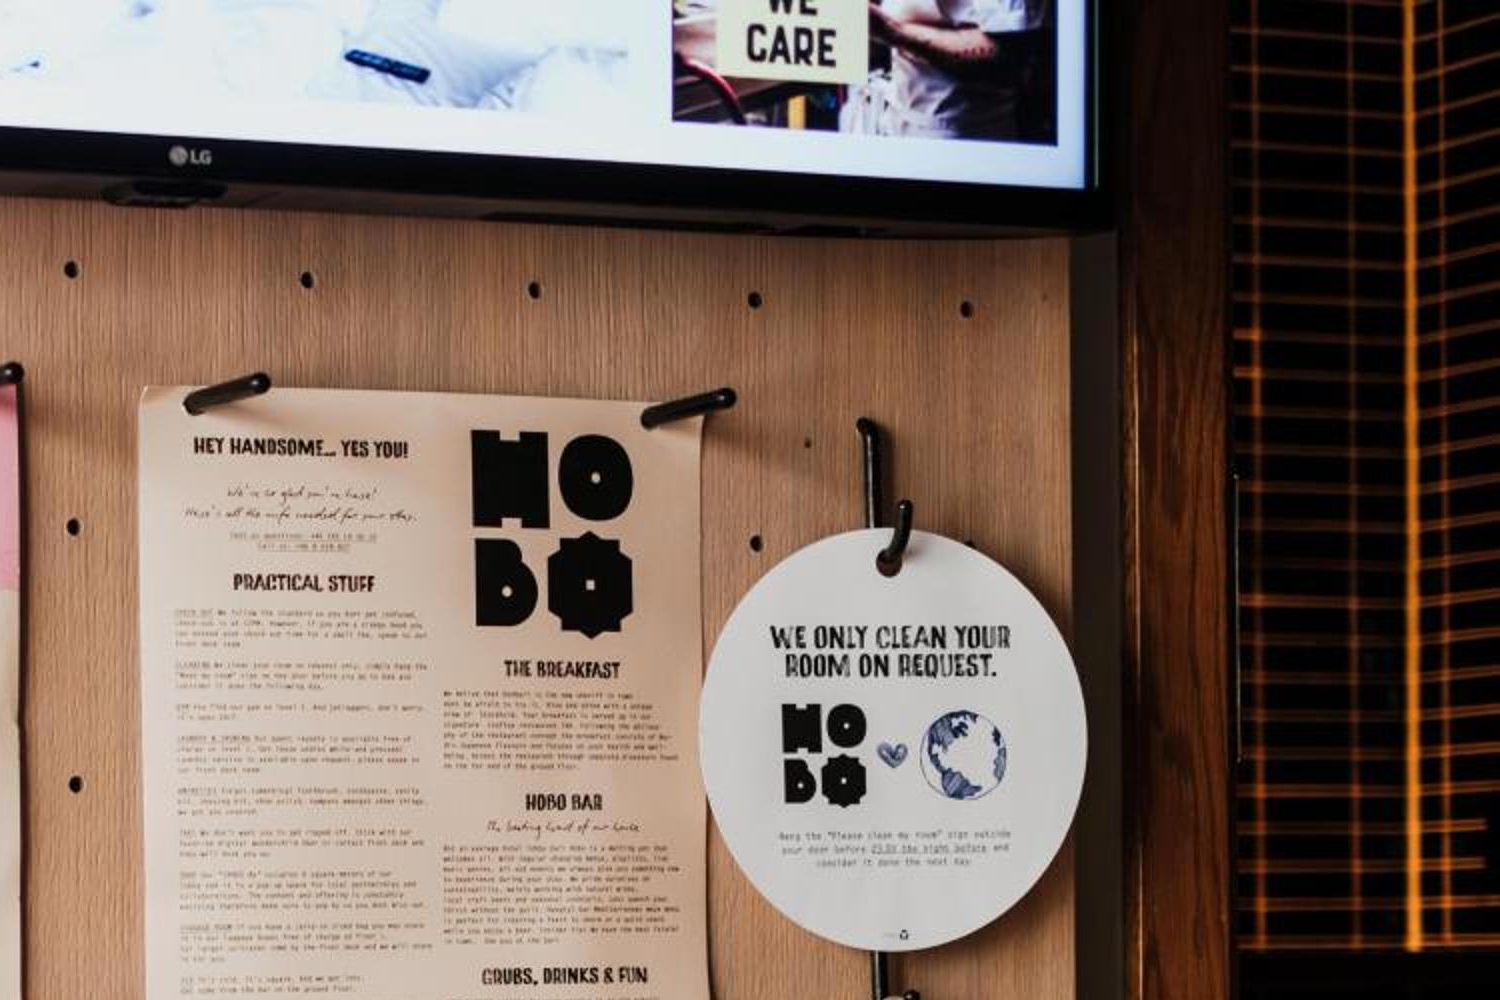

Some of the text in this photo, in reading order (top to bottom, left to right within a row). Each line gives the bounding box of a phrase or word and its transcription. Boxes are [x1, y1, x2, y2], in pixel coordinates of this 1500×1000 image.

[747, 24, 836, 66] CARE
[190, 150, 212, 165] LG
[194, 437, 224, 455] HEY
[341, 440, 369, 457] YES
[375, 441, 409, 459] YOU!
[471, 430, 634, 528] HO
[233, 574, 375, 592] PRACTICAL STUFF
[770, 625, 1011, 649] WE ONLY CLEAN YOUR
[505, 660, 620, 679] THE BREAKFAST
[785, 654, 998, 679] ROOM ON REQUEST.
[782, 704, 867, 753] HO
[526, 794, 603, 811] HOBO BAR
[482, 966, 648, 985] GRUBS, DRINKS & FUN
